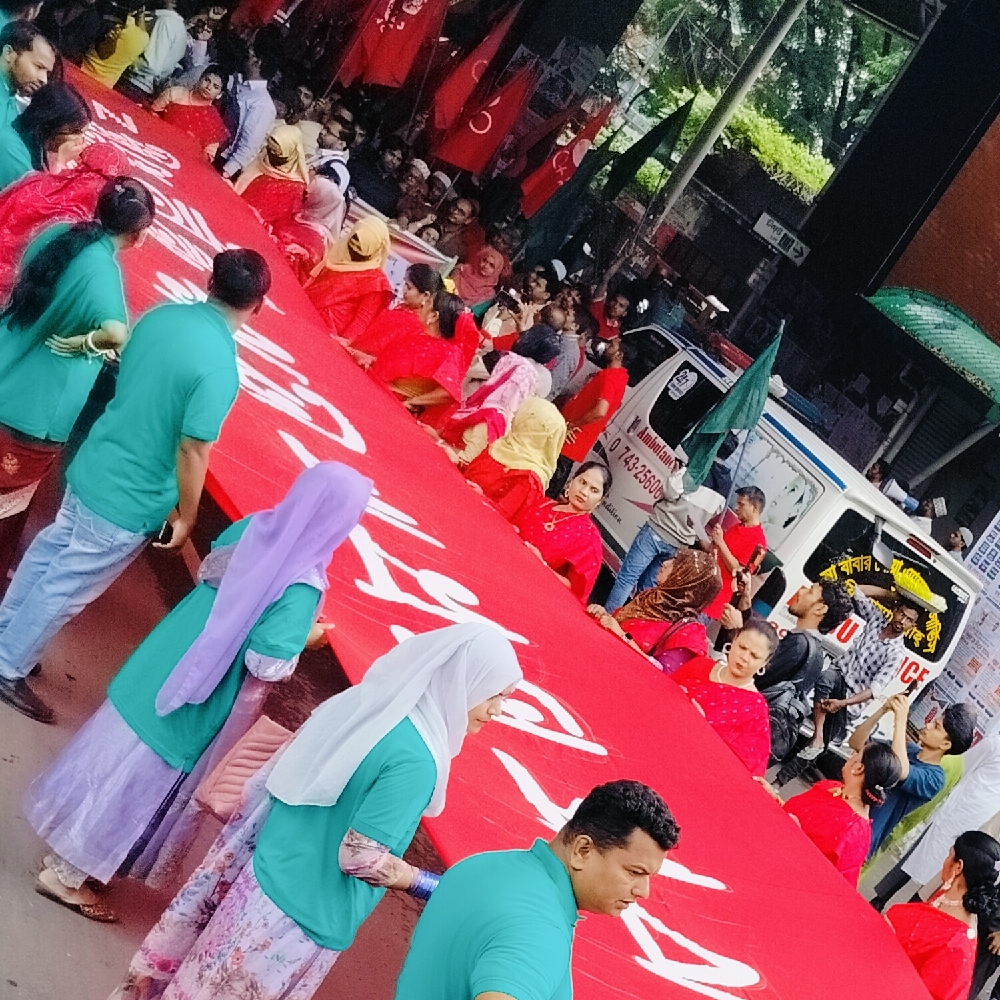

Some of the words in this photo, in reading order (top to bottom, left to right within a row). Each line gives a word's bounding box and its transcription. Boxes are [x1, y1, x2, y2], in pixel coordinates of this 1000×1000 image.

[636, 427, 678, 471] Ambulanc
[618, 446, 664, 501] 743-25606
[838, 555, 872, 576] বাবার
